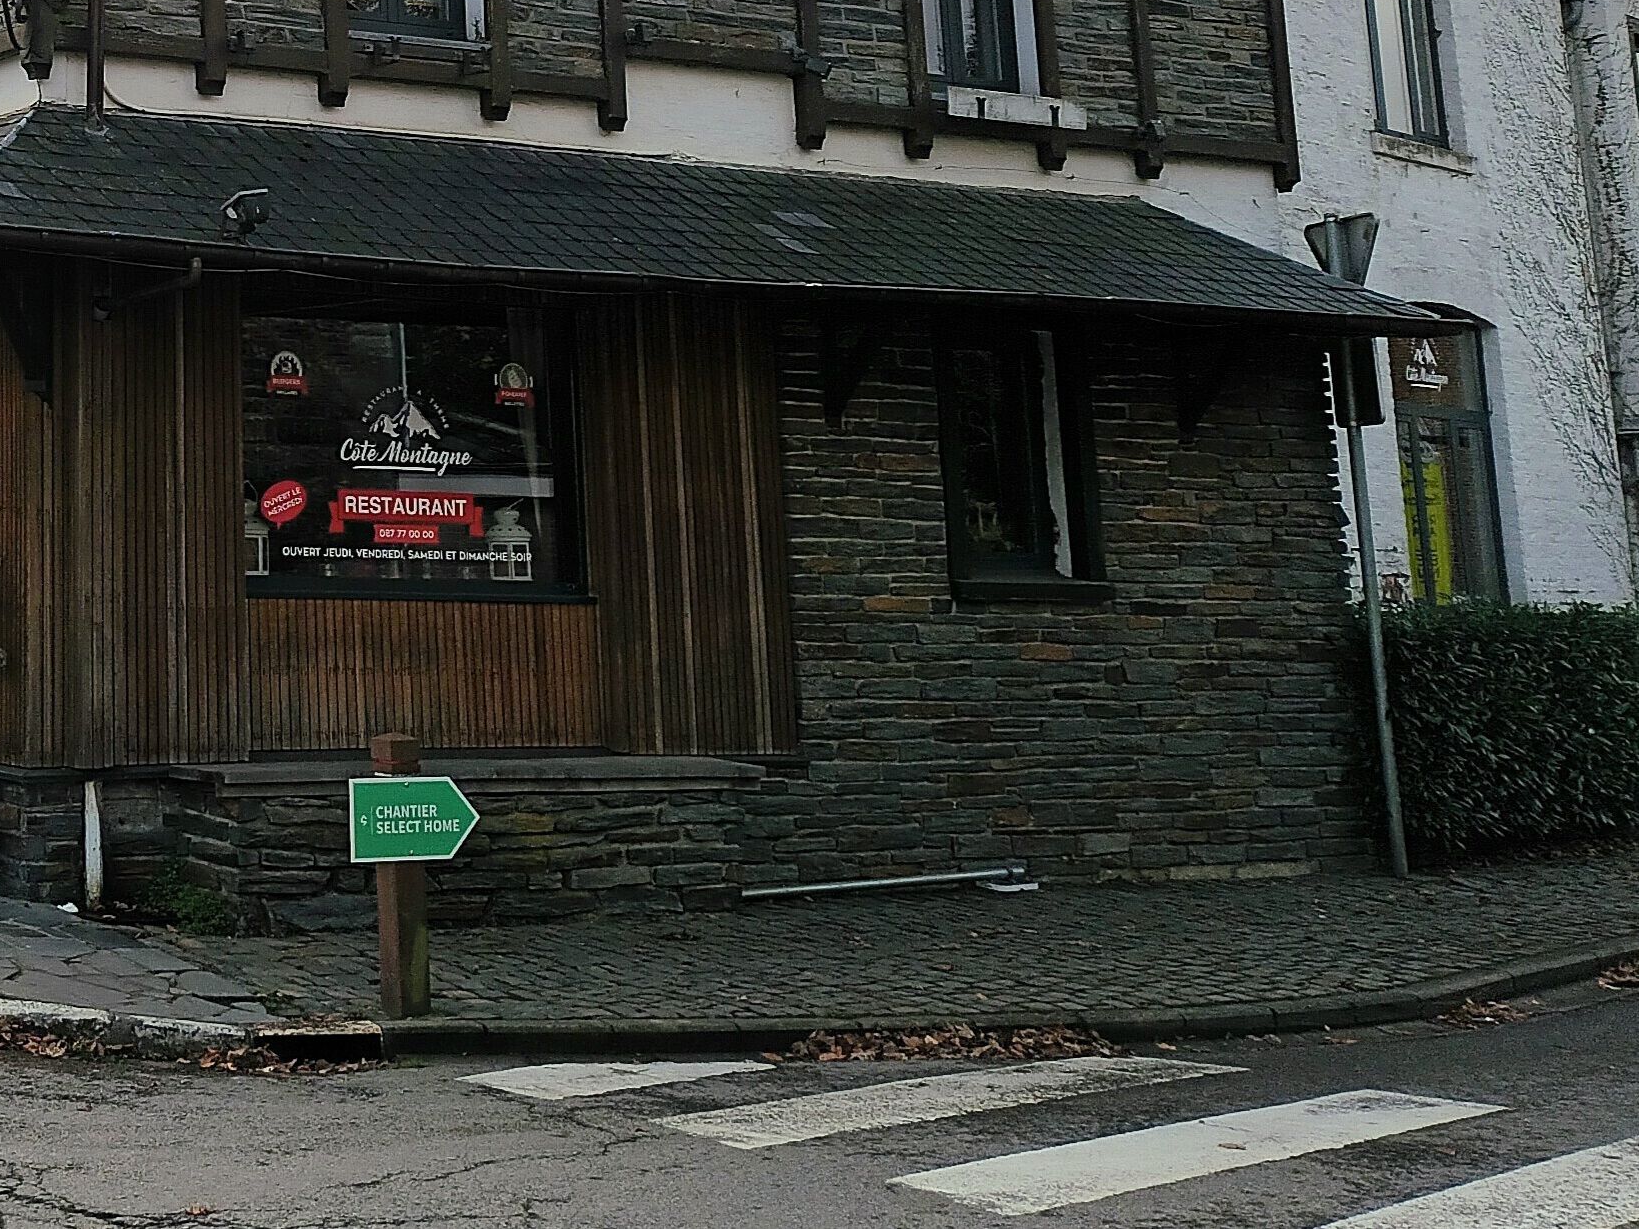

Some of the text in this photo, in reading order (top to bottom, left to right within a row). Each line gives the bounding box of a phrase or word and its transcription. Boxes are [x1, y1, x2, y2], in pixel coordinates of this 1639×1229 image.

[362, 386, 407, 423] RESTAURAN
[341, 438, 473, 477] Côte Montagne
[291, 486, 302, 496] LE
[345, 495, 467, 517] RESTAURANT
[397, 529, 406, 538] 77
[408, 529, 420, 539] 00
[422, 530, 434, 539] 00
[282, 546, 532, 562] OUVERT JEUDI, VENDREDI, SAMEDI ET DIMANCHE SOIR
[375, 804, 438, 819] CHANTIER
[376, 818, 461, 834] SELECT HOME
